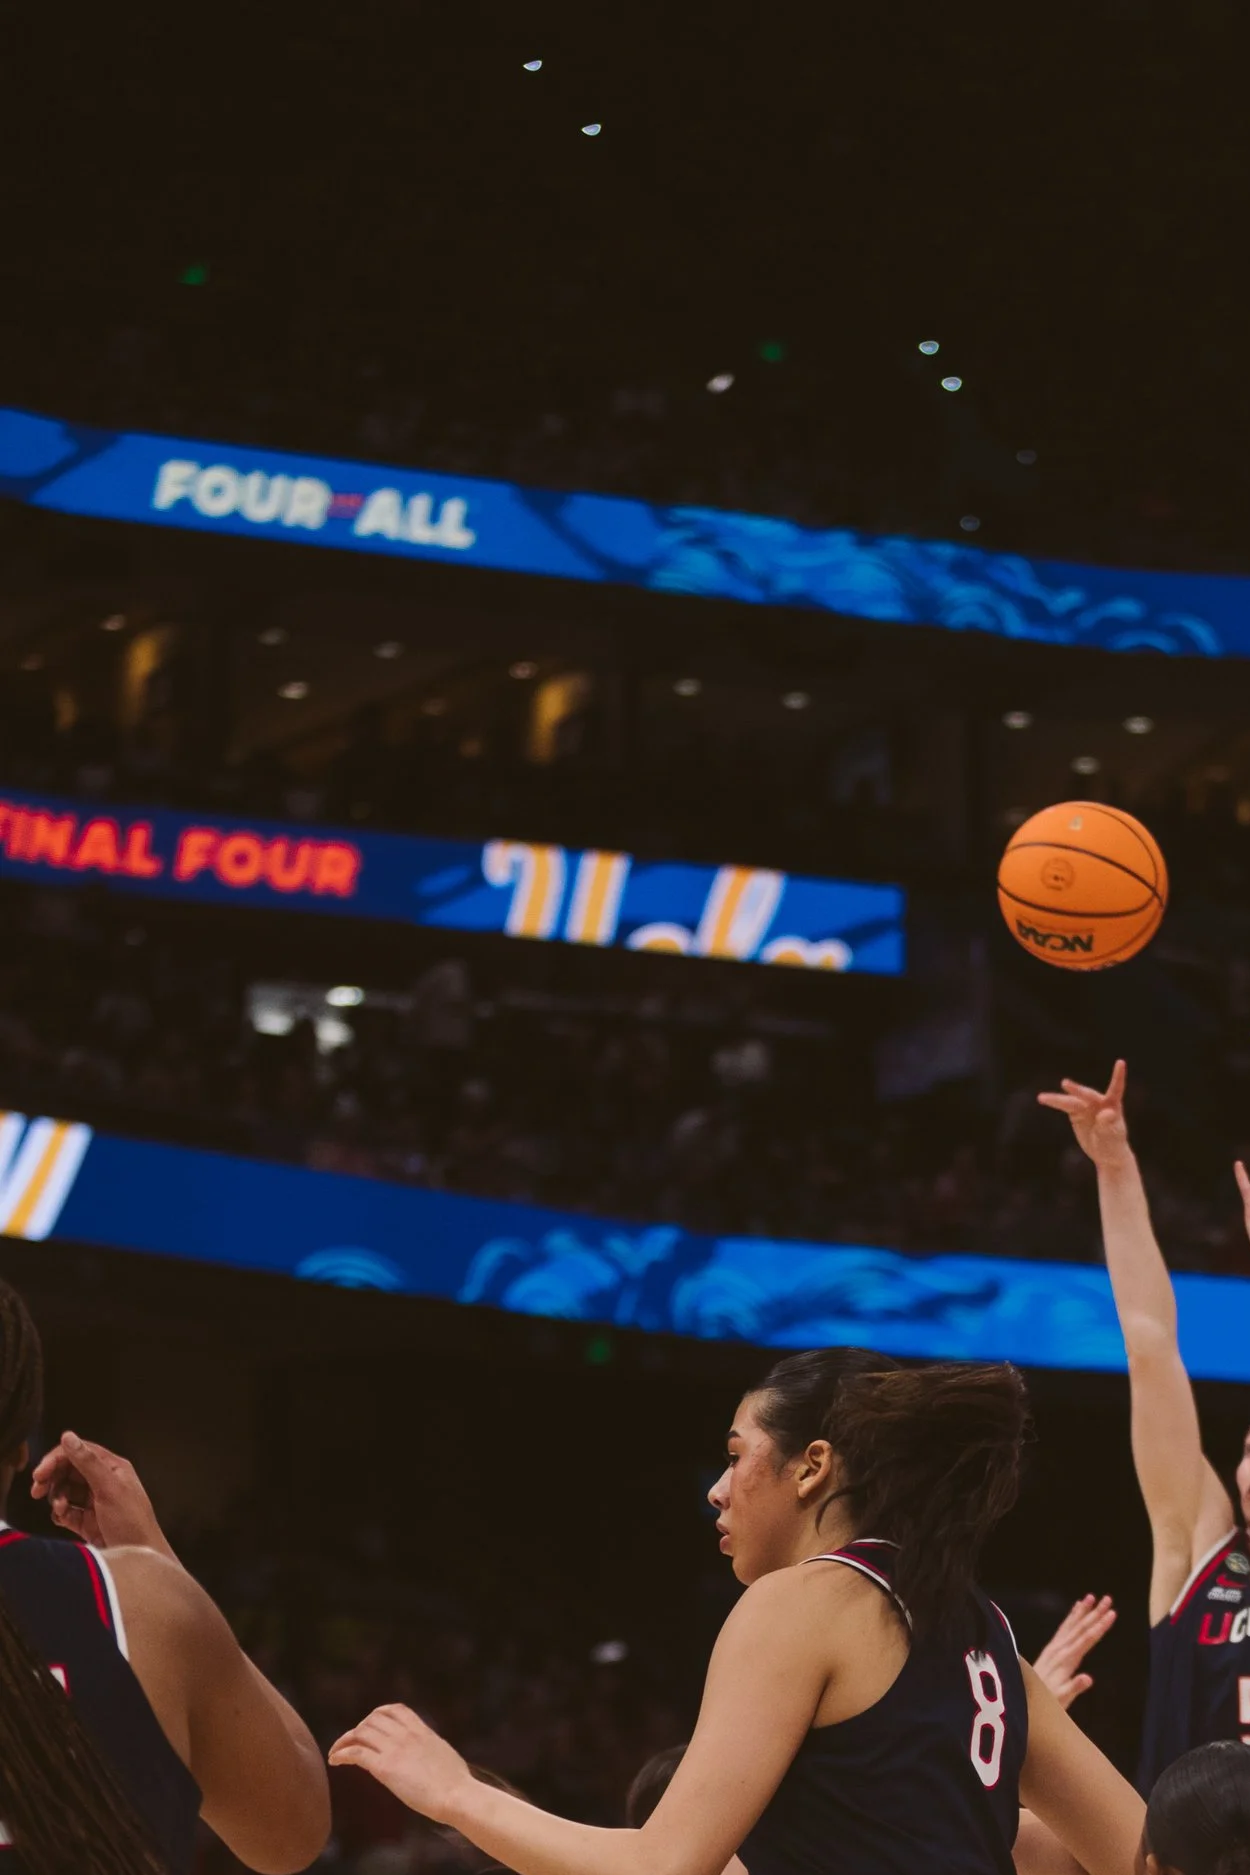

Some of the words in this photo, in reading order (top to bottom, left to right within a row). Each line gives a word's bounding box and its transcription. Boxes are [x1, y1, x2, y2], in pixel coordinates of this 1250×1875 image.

[154, 459, 332, 530] FOUR
[352, 487, 476, 550] ALL
[0, 798, 163, 880] INAL
[172, 825, 363, 898] FOUR
[1015, 915, 1094, 953] NCAA
[965, 1648, 1006, 1789] 8
